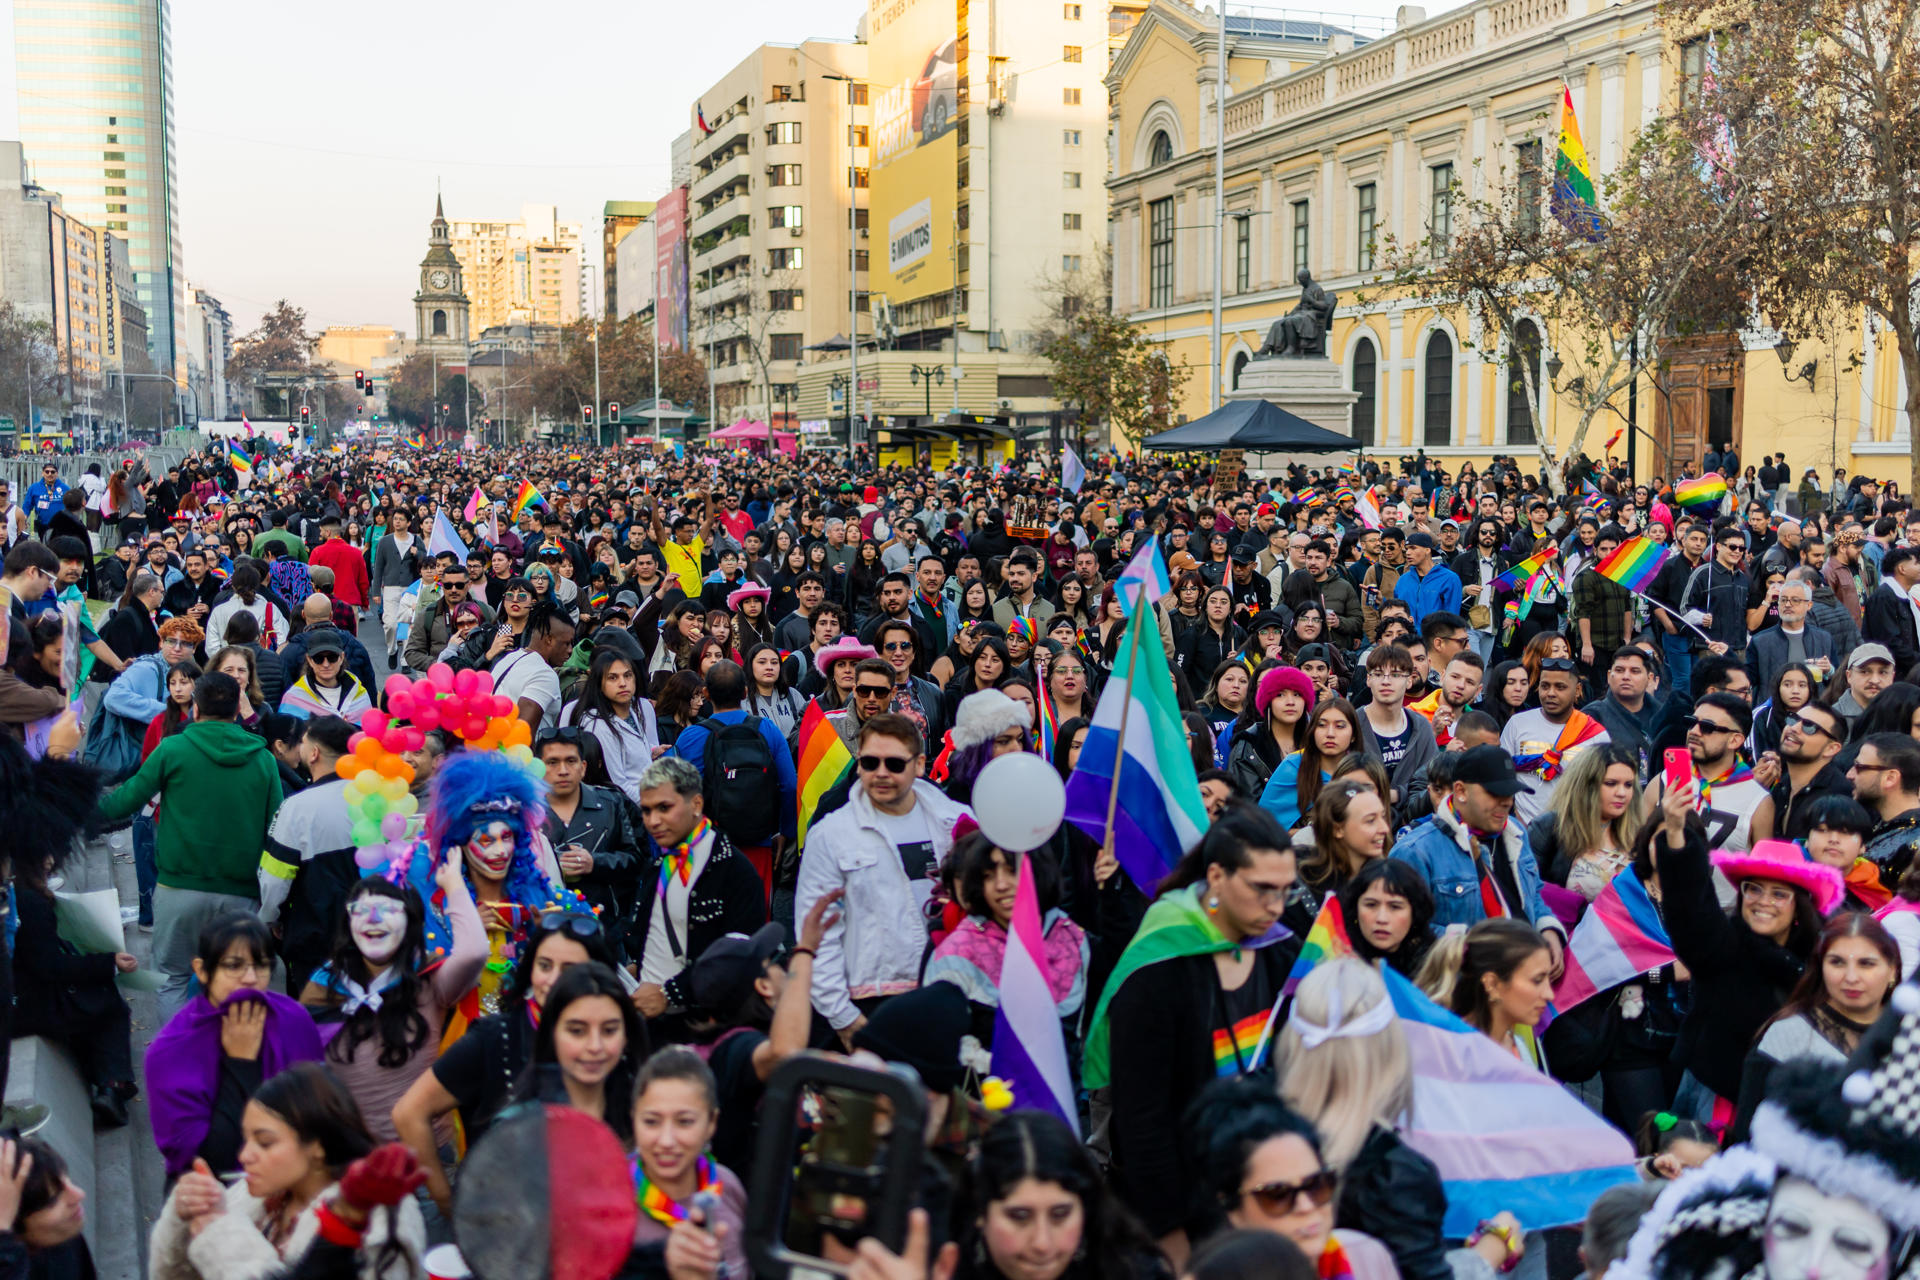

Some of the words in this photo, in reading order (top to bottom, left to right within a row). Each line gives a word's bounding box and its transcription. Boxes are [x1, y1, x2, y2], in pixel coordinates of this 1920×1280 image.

[874, 77, 912, 131] HAZLA
[877, 110, 914, 161] CORTA
[104, 232, 112, 273] HOTEL
[892, 241, 897, 263] 5
[897, 222, 930, 260] MINUTOS
